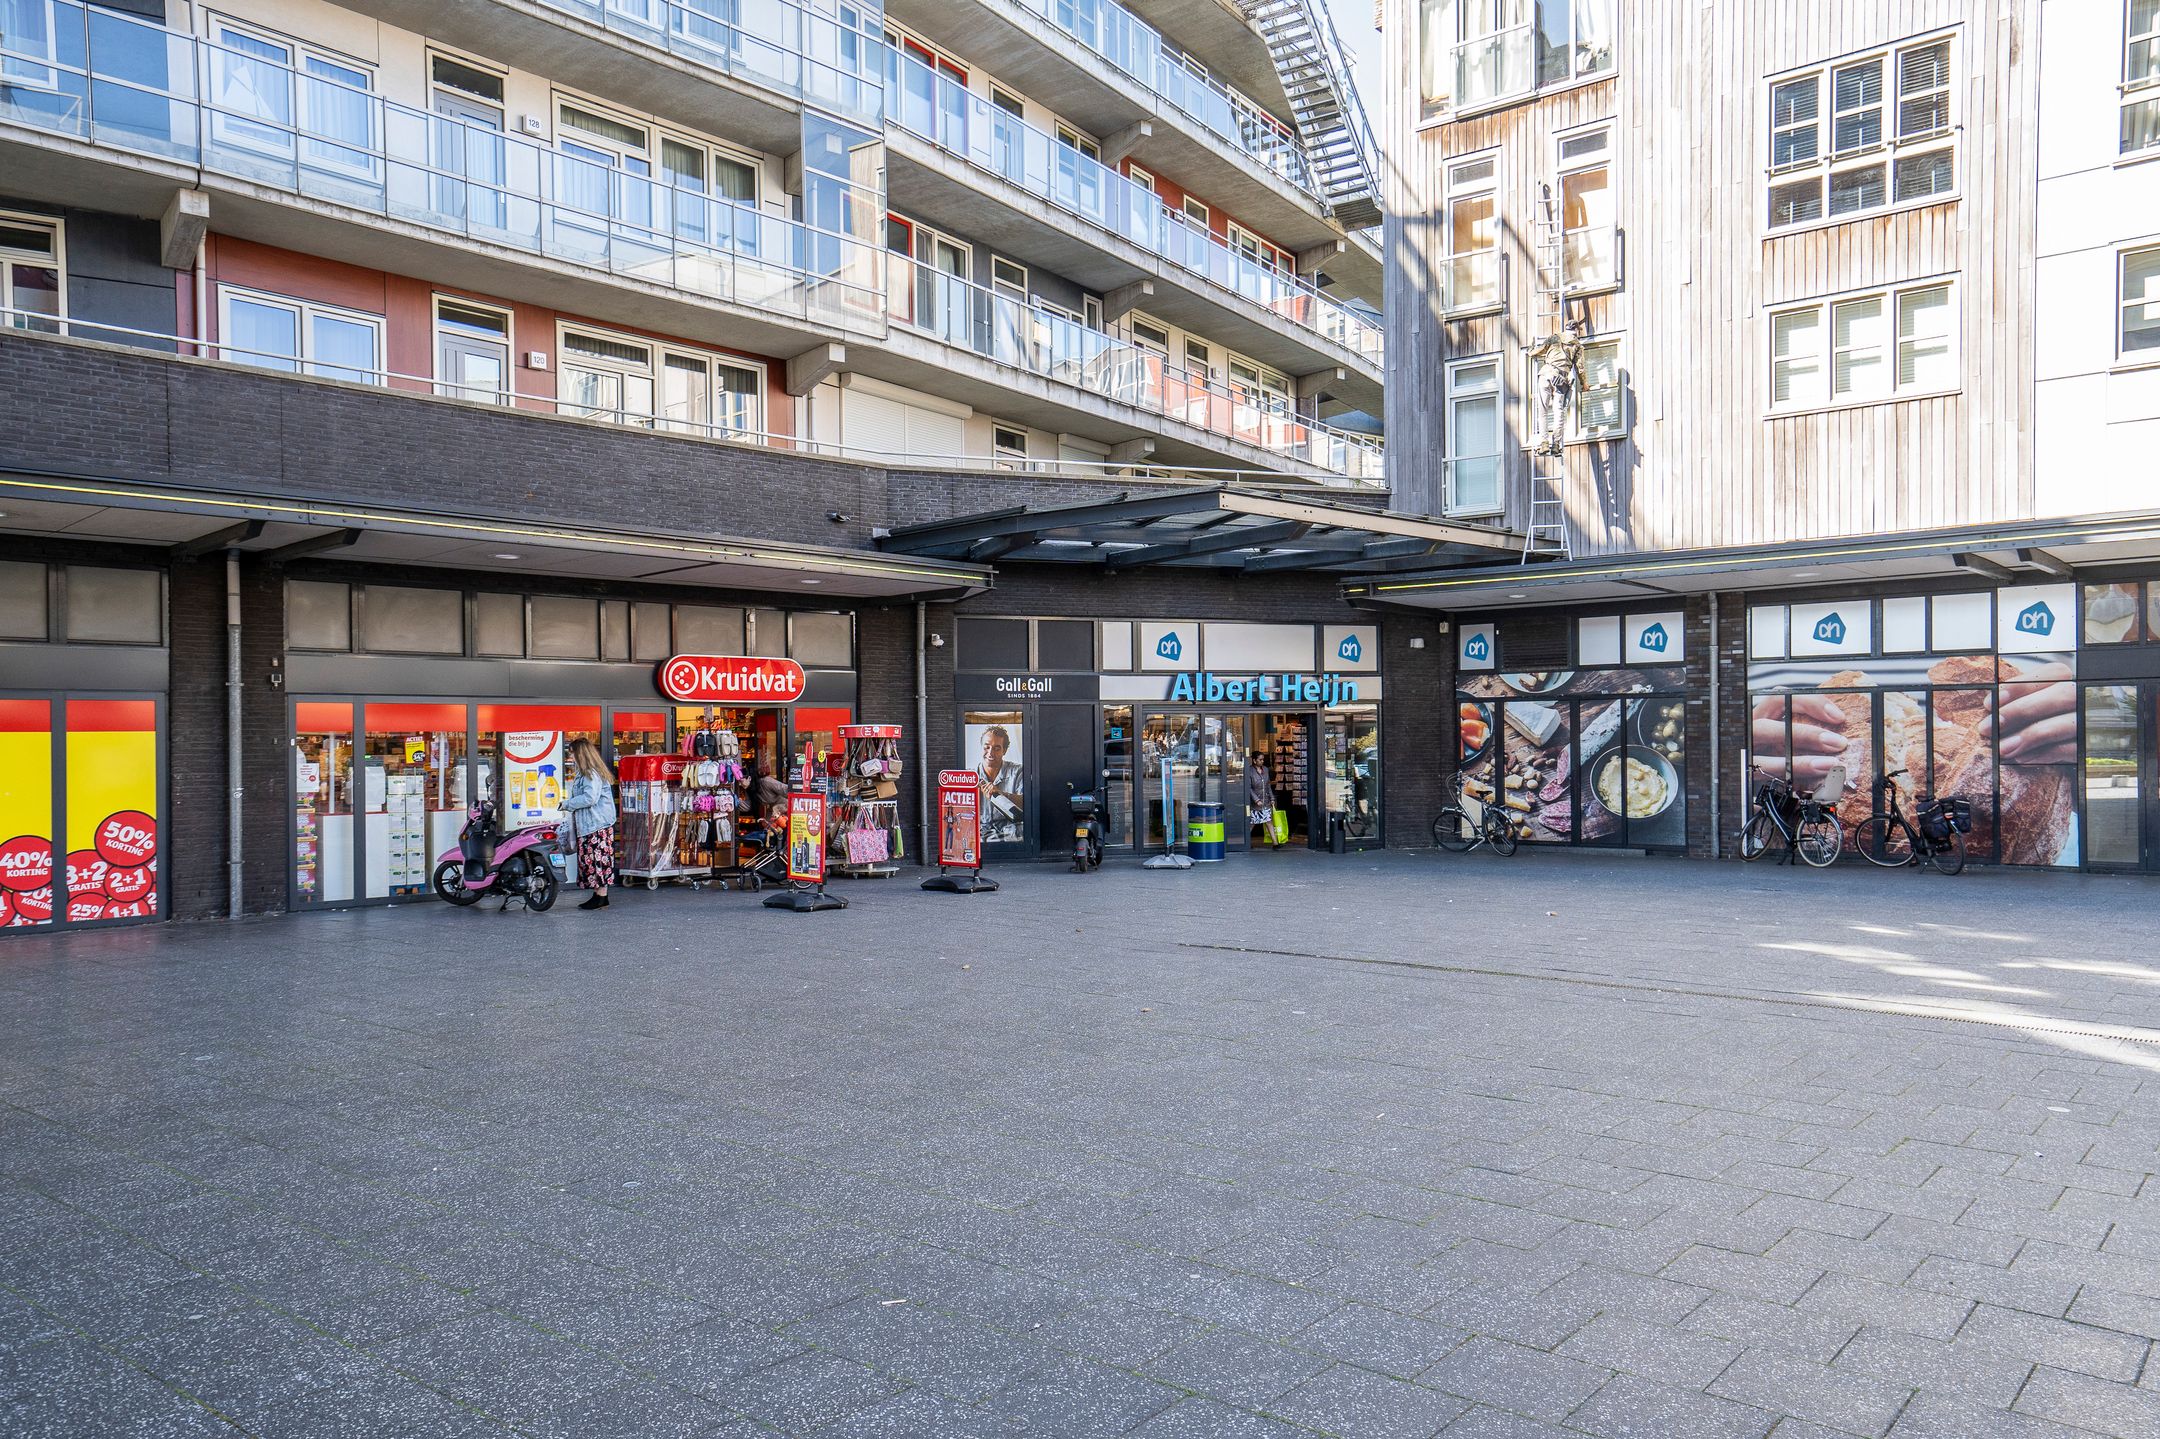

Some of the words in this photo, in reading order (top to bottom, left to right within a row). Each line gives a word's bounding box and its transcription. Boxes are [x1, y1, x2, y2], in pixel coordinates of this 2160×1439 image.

[529, 119, 540, 128] 128
[533, 356, 545, 364] 120
[701, 666, 796, 692] Kruidvat
[1170, 672, 1271, 702] Albert
[1282, 673, 1359, 707] Heijn
[949, 774, 976, 784] Kruidvat
[793, 797, 820, 812] ACTIE!
[944, 791, 975, 806] ACTIE!
[808, 815, 820, 826] 2+2
[103, 821, 154, 850] 50%
[105, 839, 145, 857] KORTING
[0, 851, 52, 869] 40%
[6, 868, 48, 877] KORTING
[66, 861, 107, 885] 3+2
[109, 868, 146, 888] 2+1
[109, 902, 141, 918] 1+1
